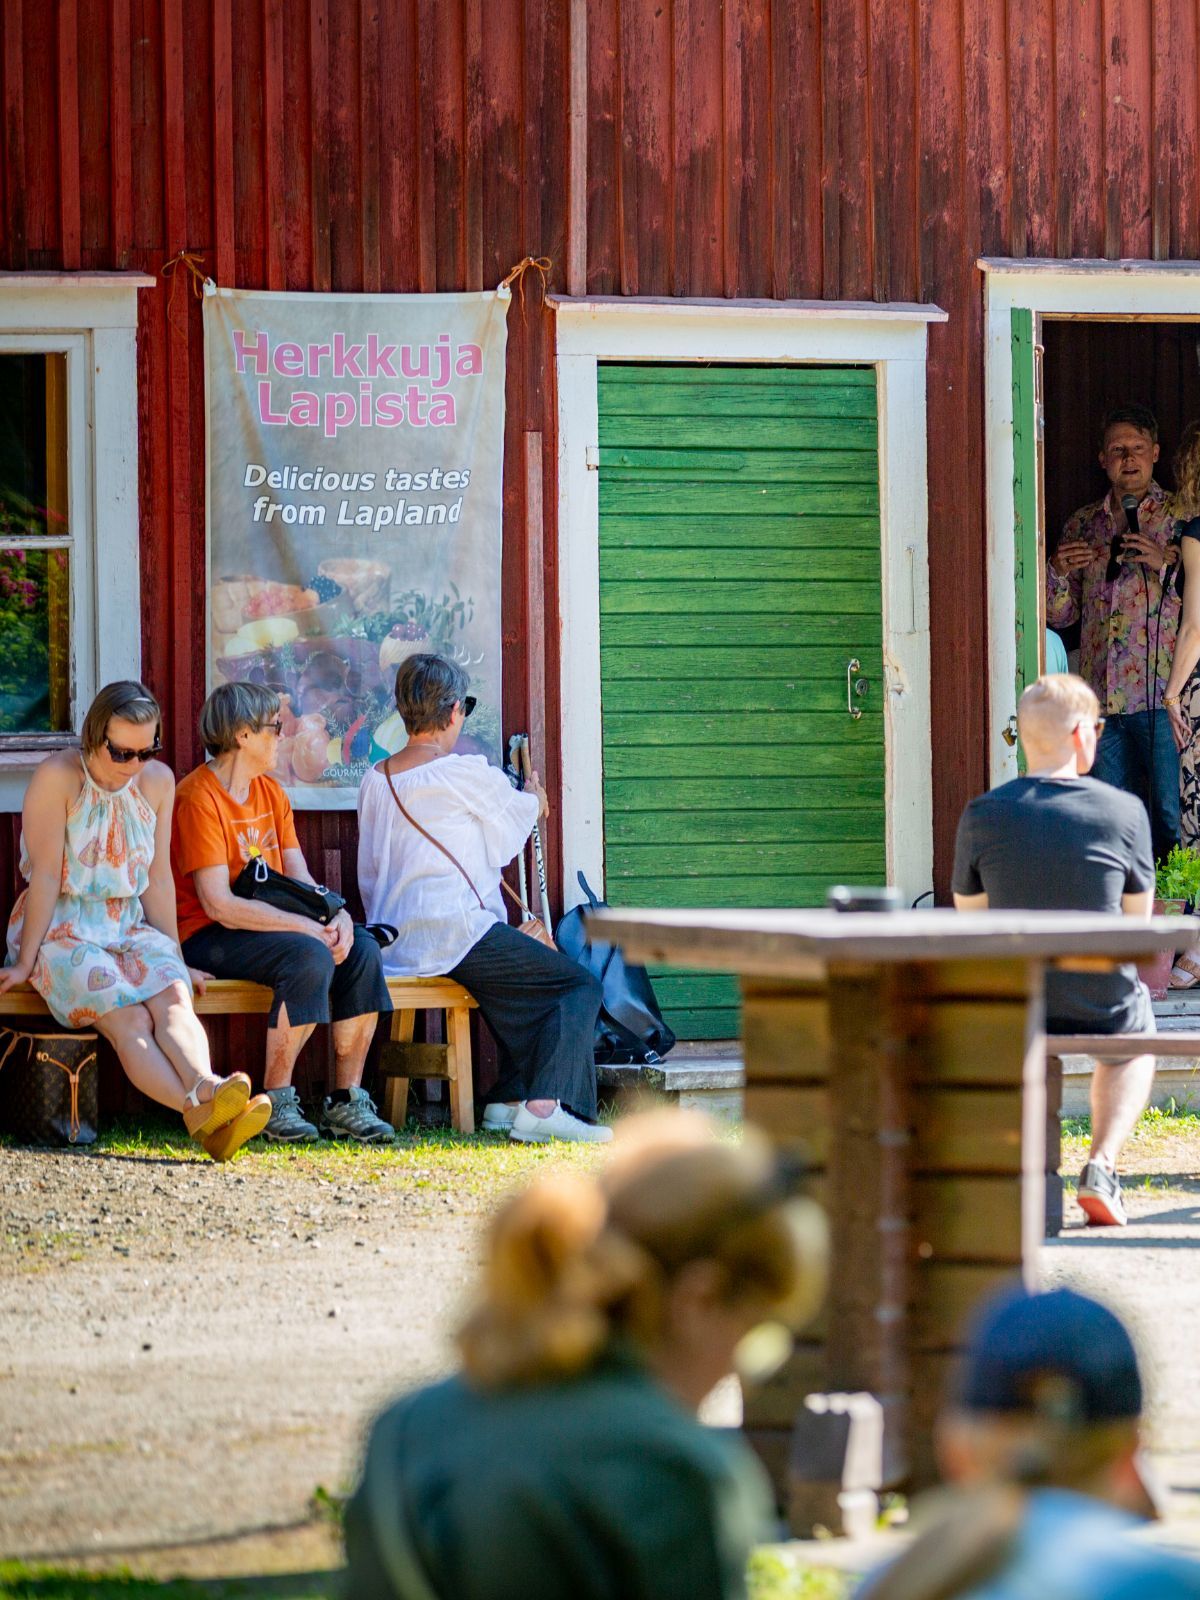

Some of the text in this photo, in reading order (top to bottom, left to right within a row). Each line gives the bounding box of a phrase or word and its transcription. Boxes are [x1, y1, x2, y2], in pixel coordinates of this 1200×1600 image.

[232, 329, 484, 388] Herkkuja
[258, 380, 457, 438] Lapista
[243, 463, 472, 492] Delicious tastes
[252, 496, 463, 533] from Lapland
[322, 767, 367, 778] GOURME
